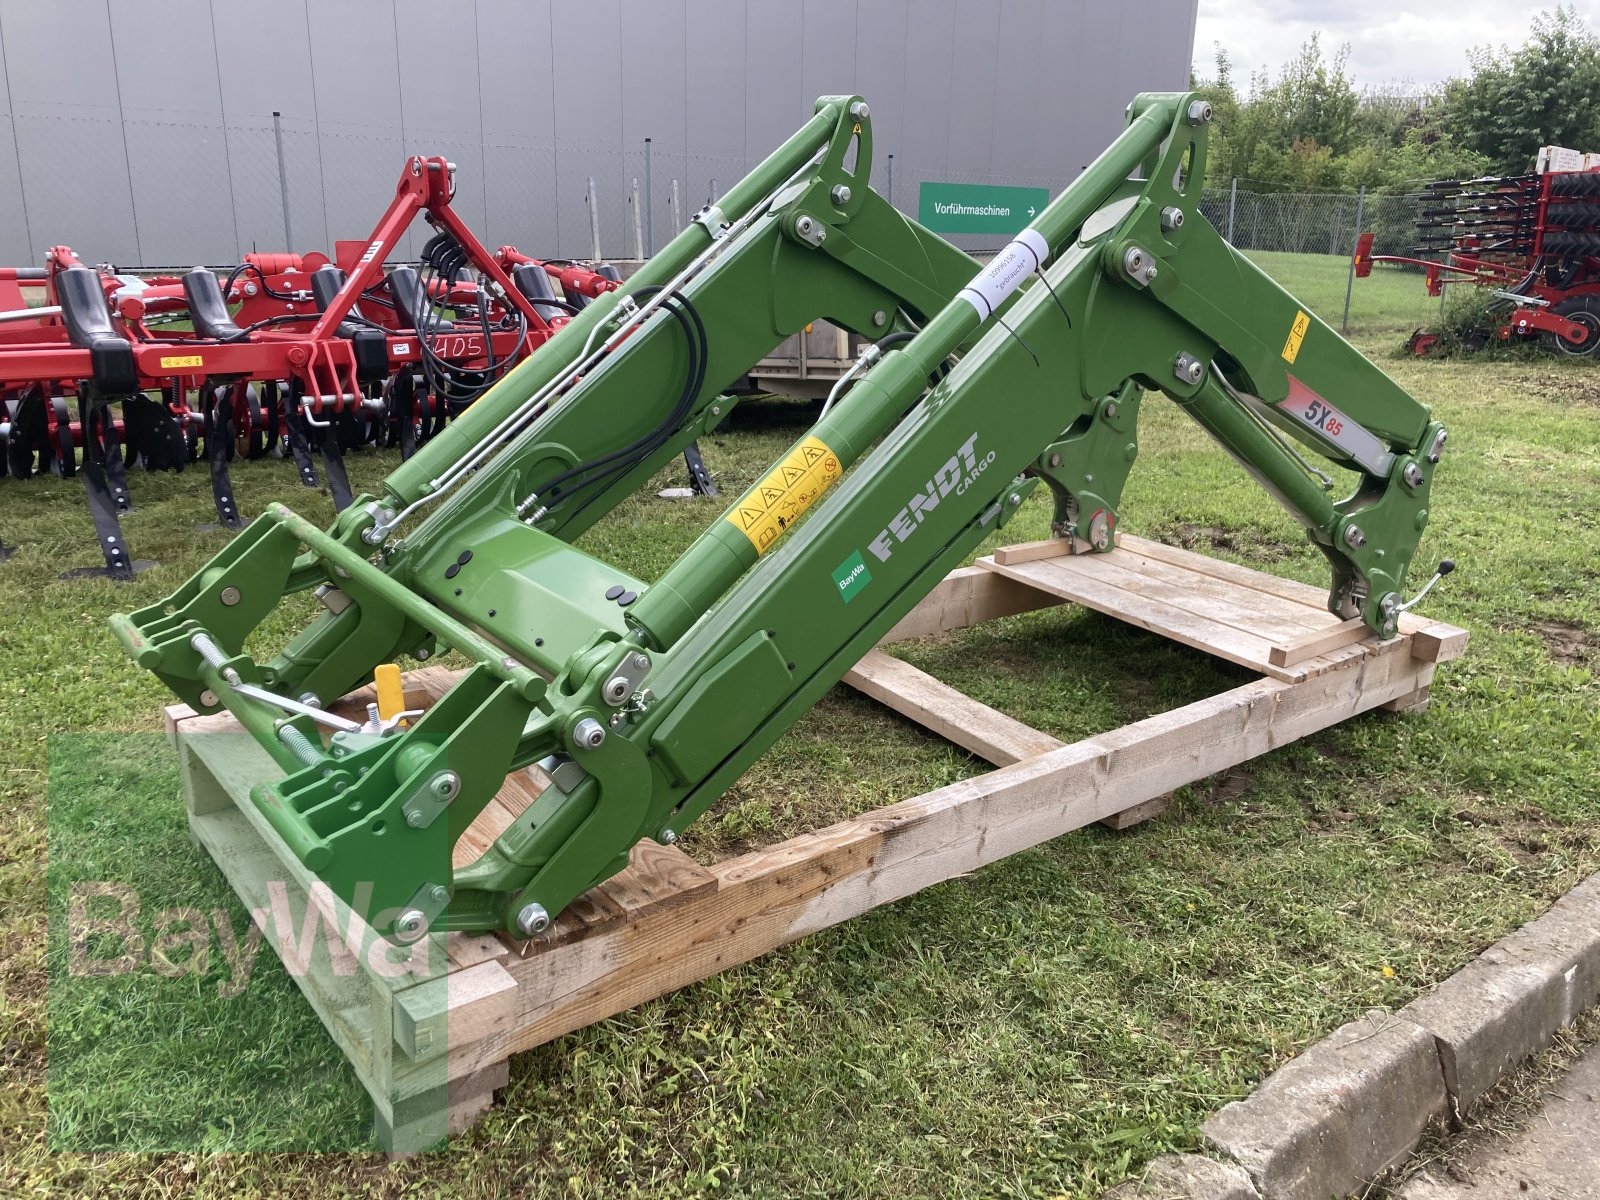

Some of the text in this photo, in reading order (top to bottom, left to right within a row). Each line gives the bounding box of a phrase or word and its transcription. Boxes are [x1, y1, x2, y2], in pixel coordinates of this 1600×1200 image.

[934, 202, 1010, 216] Vorführmaschinen
[955, 450, 996, 496] CARGO
[867, 431, 978, 563] FENDT
[839, 563, 865, 590] BayWa
